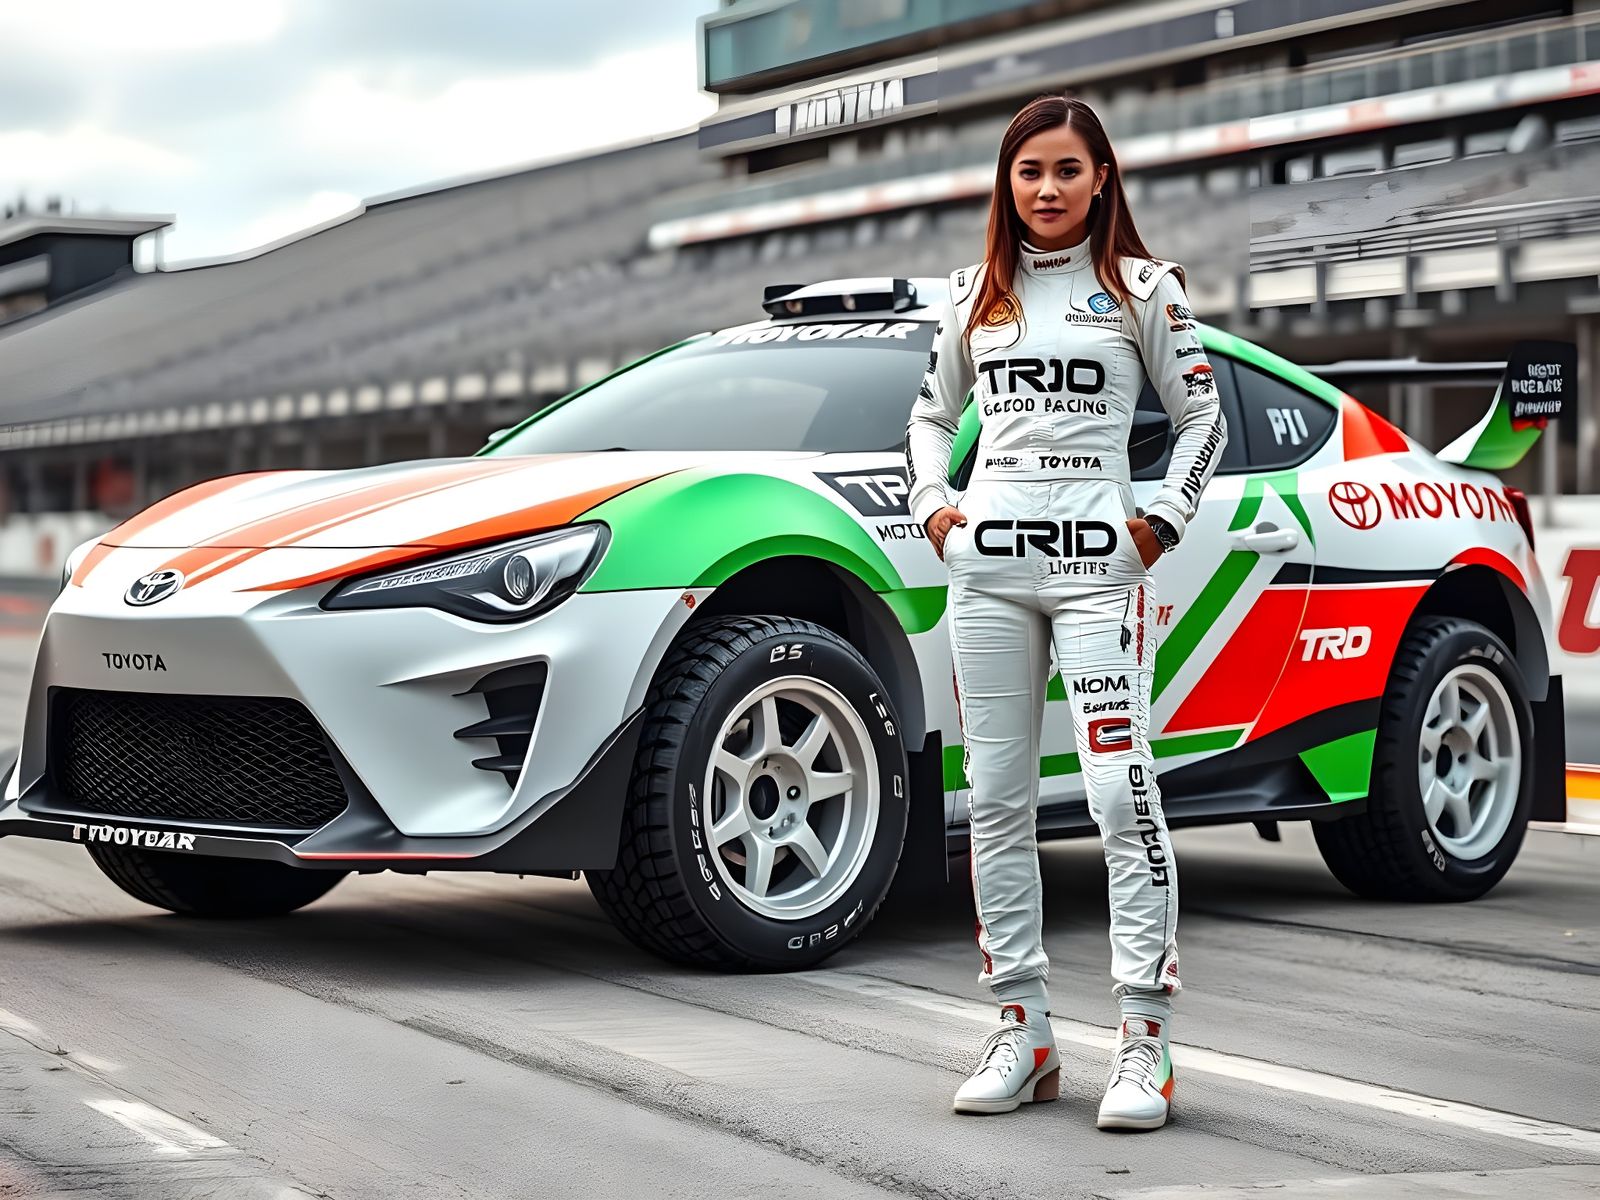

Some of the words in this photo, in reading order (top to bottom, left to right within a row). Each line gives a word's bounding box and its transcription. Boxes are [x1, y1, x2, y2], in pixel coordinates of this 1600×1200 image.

[974, 519, 1118, 558] CRID
[102, 652, 167, 671] TOYOTA
[1299, 625, 1373, 662] TRD
